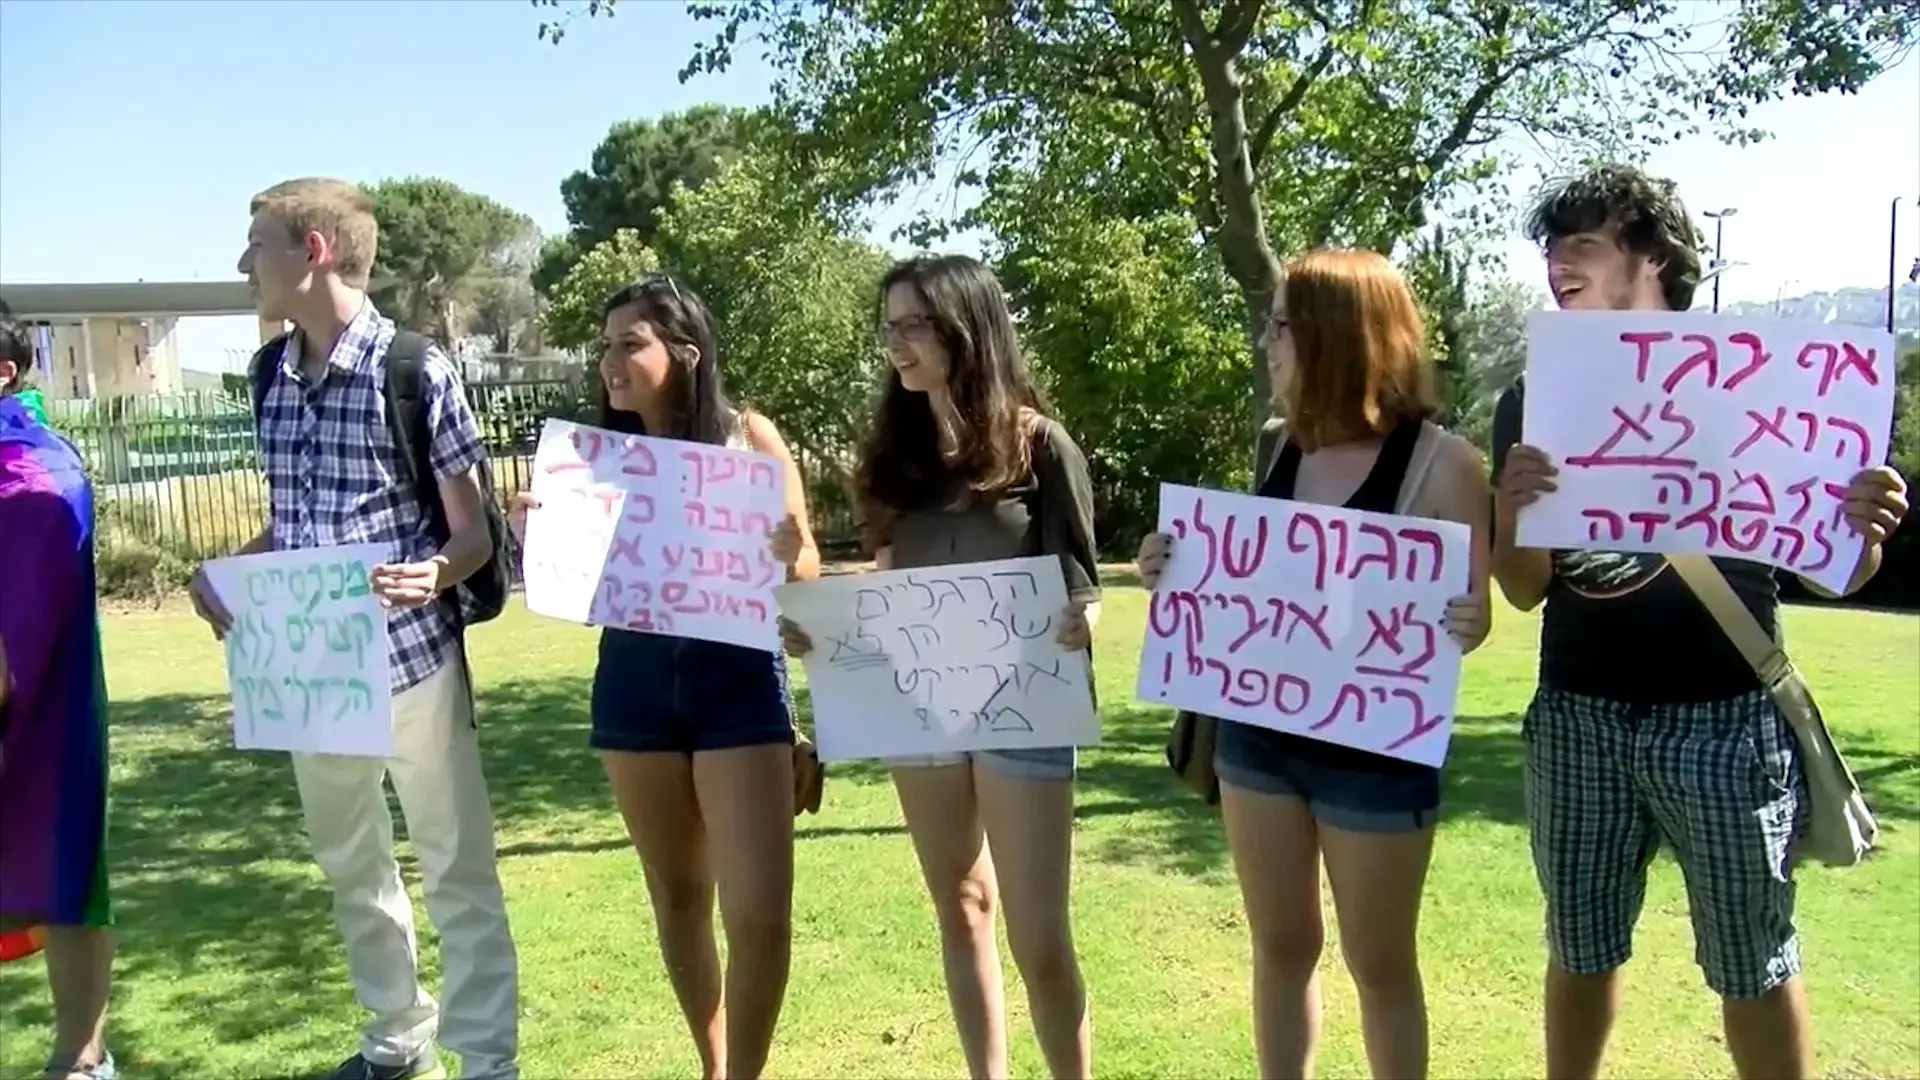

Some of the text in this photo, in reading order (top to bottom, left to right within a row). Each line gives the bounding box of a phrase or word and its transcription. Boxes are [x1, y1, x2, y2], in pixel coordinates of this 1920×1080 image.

[1619, 331, 1880, 397] אף בגד
[1593, 400, 1873, 467] הוא לא
[1173, 496, 1445, 592] הגוף שלי
[1580, 506, 1834, 572] להטרדה
[246, 559, 371, 614] מכנסיים
[856, 571, 1038, 621] הרגליים
[229, 610, 374, 671] קצרים ללא
[605, 604, 676, 633] הבא
[825, 600, 1051, 662] שלי הן לא
[1355, 602, 1436, 674] לא
[236, 675, 285, 738] מין
[894, 658, 1073, 713] אובייקט
[1308, 683, 1446, 751] בית
